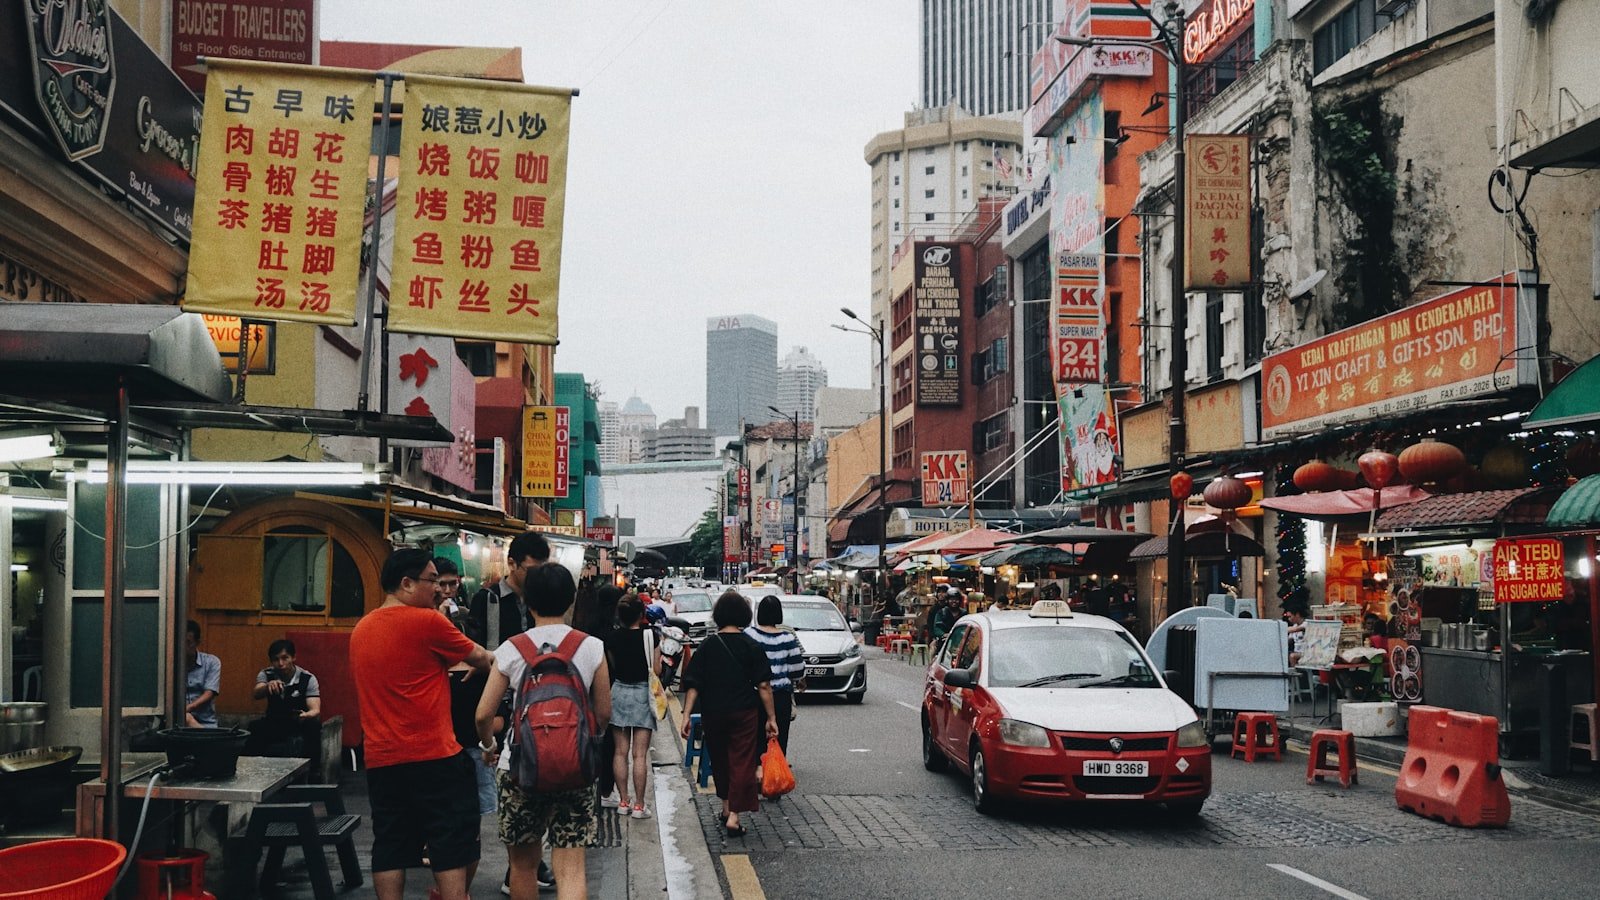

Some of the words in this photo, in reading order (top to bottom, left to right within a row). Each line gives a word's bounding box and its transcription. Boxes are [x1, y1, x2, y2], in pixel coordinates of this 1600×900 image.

[179, 1, 227, 36] BUDGET
[232, 4, 306, 42] TRAVELLERS
[179, 41, 193, 52] 1st
[197, 42, 223, 55] Floor
[228, 45, 254, 57] (Side
[258, 47, 306, 61] Entrance)
[1112, 51, 1132, 61] KK
[224, 85, 355, 124] 古早味
[421, 104, 547, 140] 娘惹小炒
[218, 123, 254, 230] 肉骨茶
[1195, 201, 1244, 210] DAGING
[1200, 192, 1241, 201] KEDAI
[254, 127, 300, 309] 胡椒猪肚汤
[299, 131, 346, 314] 花生猪脚汤
[1200, 211, 1241, 220] SALAI
[408, 142, 451, 310] 烧烤鱼虾
[457, 145, 500, 313] 饭粥粉丝
[925, 266, 951, 277] BARANG
[1060, 255, 1080, 267] PASAR
[1082, 255, 1098, 268] RAYA
[921, 277, 955, 288] PERHIASAN
[1060, 287, 1098, 306] KK
[717, 317, 741, 329] AIA
[1060, 325, 1080, 336] SUPER
[1081, 326, 1098, 336] MART
[1300, 346, 1325, 368] KEDAI
[1327, 325, 1385, 360] KRAFTANGAN
[1390, 317, 1411, 341] DAN
[1415, 289, 1496, 332] CENDERAMATA
[1061, 340, 1097, 366] 24
[1296, 373, 1309, 393] YI
[1311, 366, 1332, 390] XIN
[1335, 354, 1371, 382] CRAFT
[1377, 350, 1387, 369] &
[1392, 335, 1432, 365] GIFTS
[1435, 324, 1468, 353] SDN.
[1472, 312, 1507, 342] BHD.
[1063, 366, 1097, 379] JAM
[1397, 399, 1411, 409] 2026
[1441, 388, 1454, 399] FAX
[1460, 385, 1468, 395] 03
[1474, 380, 1490, 391] 2026
[556, 413, 568, 491] HOTEL
[927, 454, 961, 480] KK
[741, 467, 749, 507] HOTEL
[925, 481, 938, 502] BUKA
[939, 481, 951, 502] 24
[953, 479, 966, 502] JAM
[915, 521, 952, 532] HOTEL
[1496, 544, 1520, 562] AIR
[1523, 543, 1561, 561] TEBU
[1496, 561, 1562, 581] 纯正甘蔗水
[1498, 585, 1508, 599] A1
[1510, 583, 1539, 599] SUGAR
[1540, 582, 1563, 598] CANE
[1088, 763, 1110, 775] HWD
[1115, 763, 1144, 775] 9368
